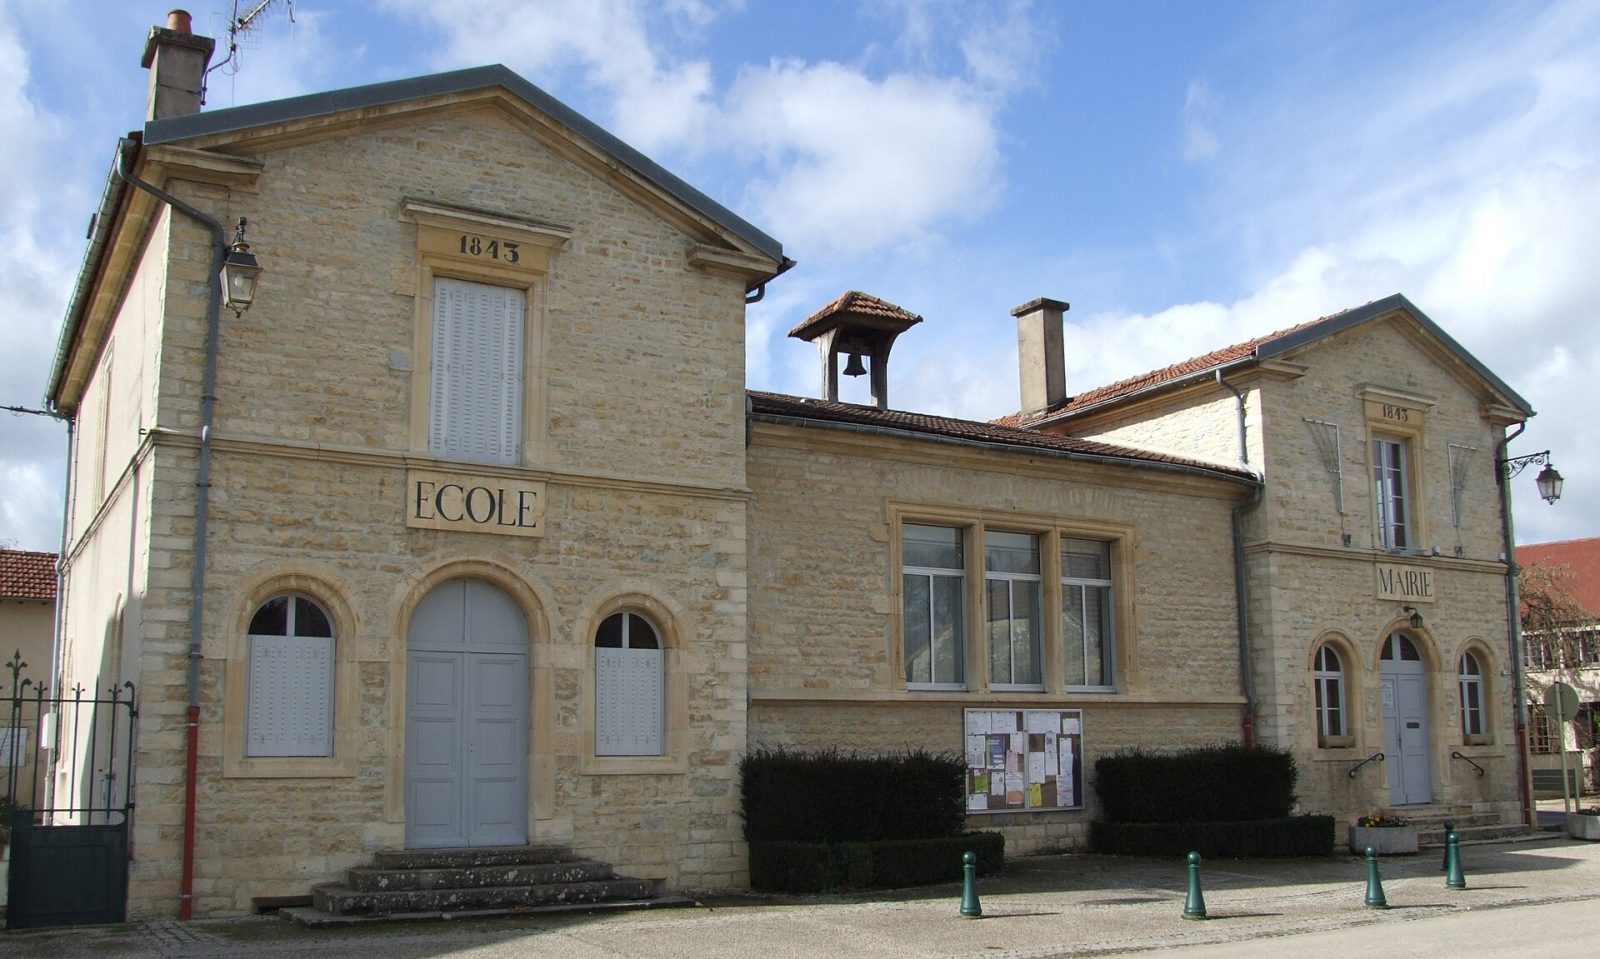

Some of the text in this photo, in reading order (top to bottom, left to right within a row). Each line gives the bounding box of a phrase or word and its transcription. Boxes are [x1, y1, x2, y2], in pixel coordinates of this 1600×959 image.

[459, 235, 520, 263] 1843
[1382, 404, 1409, 422] 1843
[414, 481, 537, 528] ECOLE
[1379, 568, 1432, 597] MAIRIE
